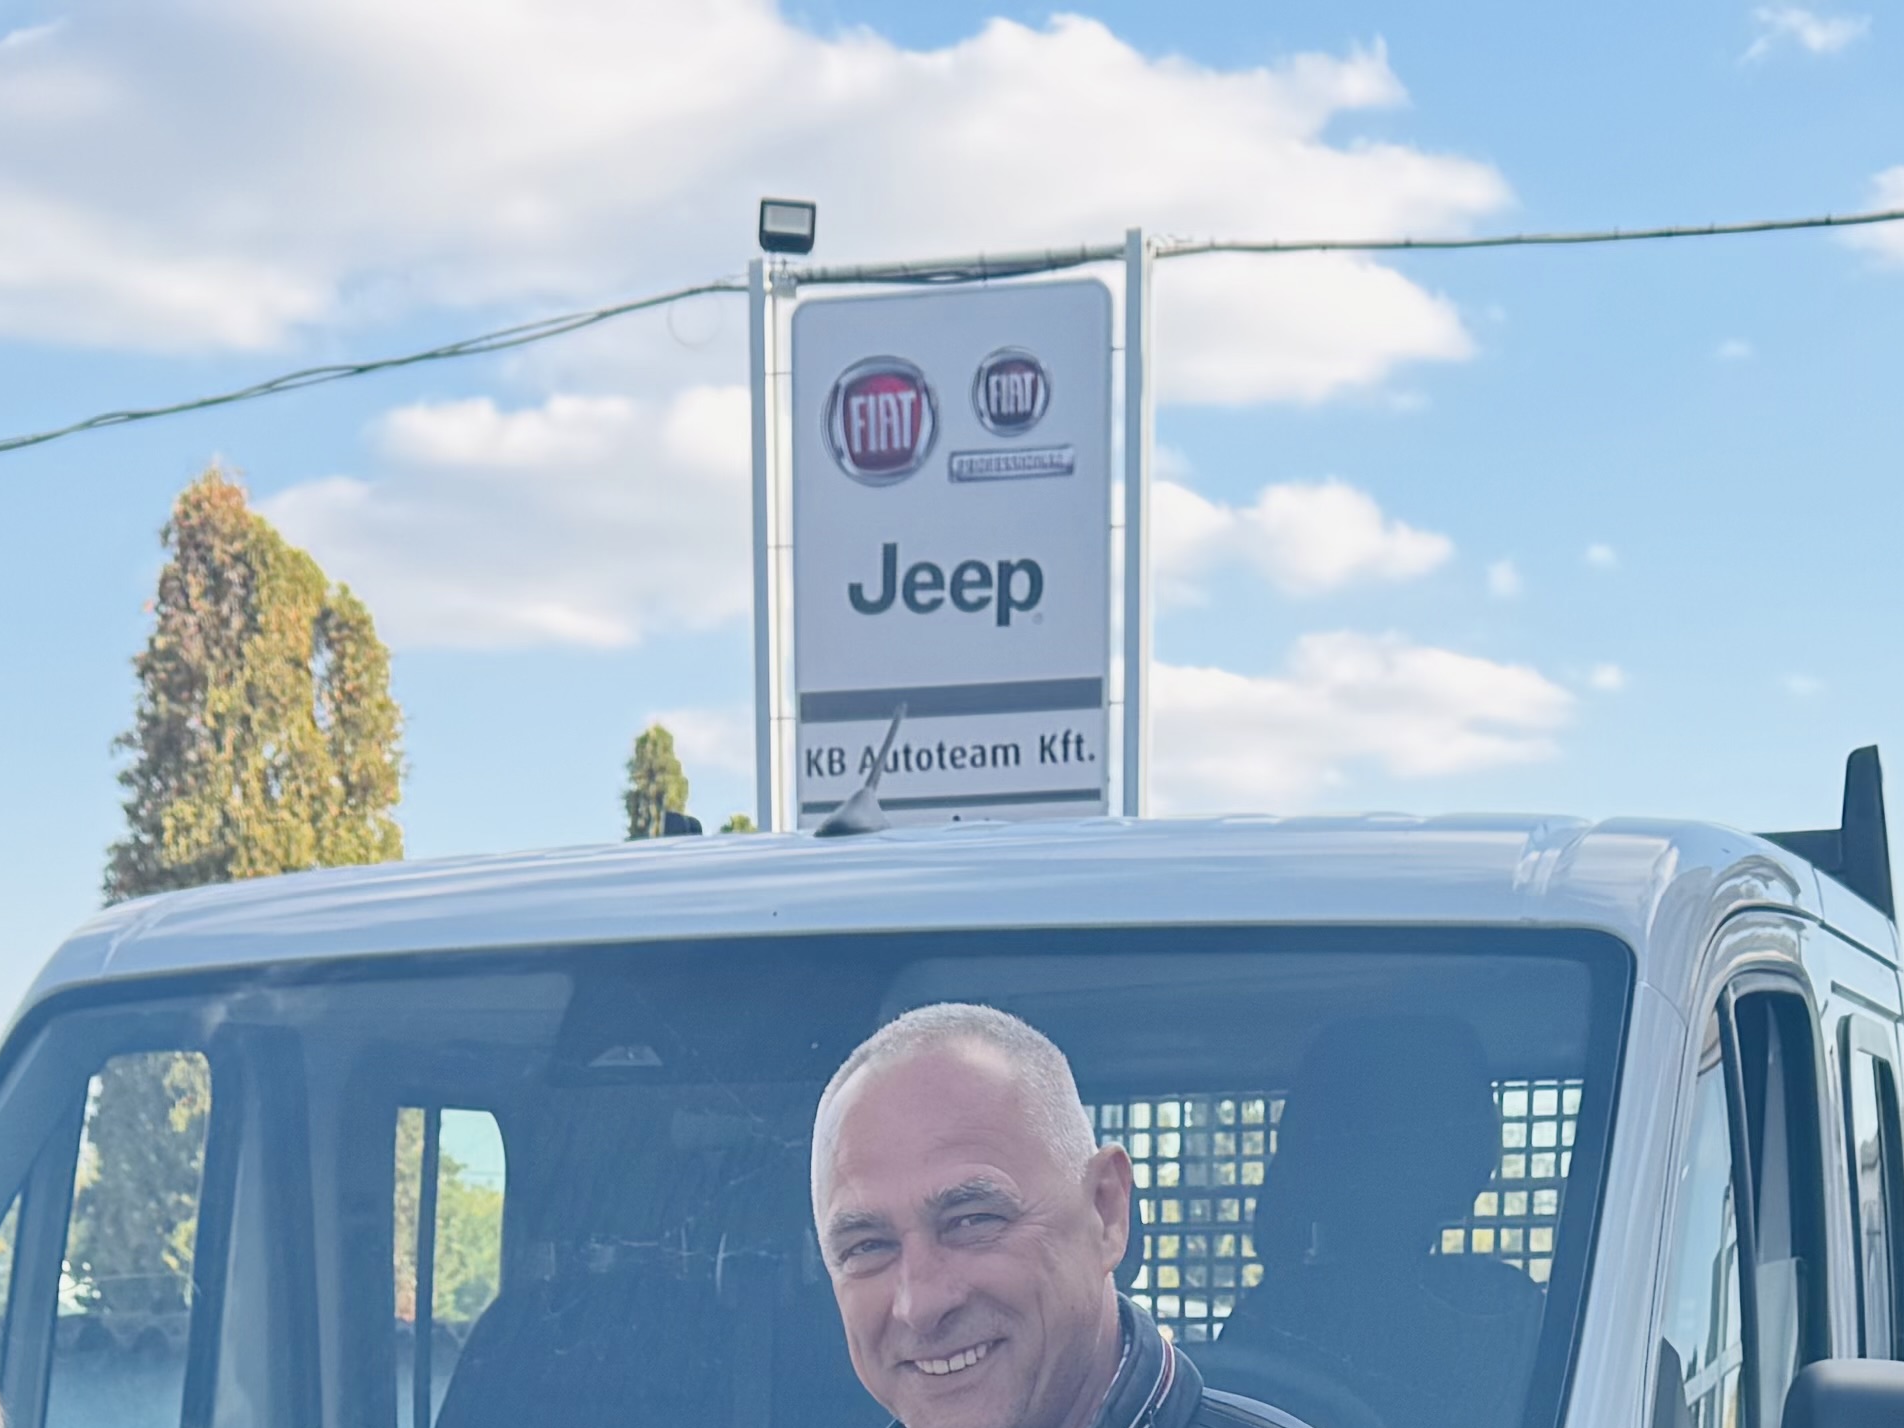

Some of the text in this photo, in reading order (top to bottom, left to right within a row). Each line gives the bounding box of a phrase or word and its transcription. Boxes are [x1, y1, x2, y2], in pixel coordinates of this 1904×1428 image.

[849, 390, 917, 455] FIAT
[987, 372, 1036, 416] FIAT
[848, 542, 1044, 628] Jeep
[805, 729, 1095, 778] KB Autoteam Kft.
